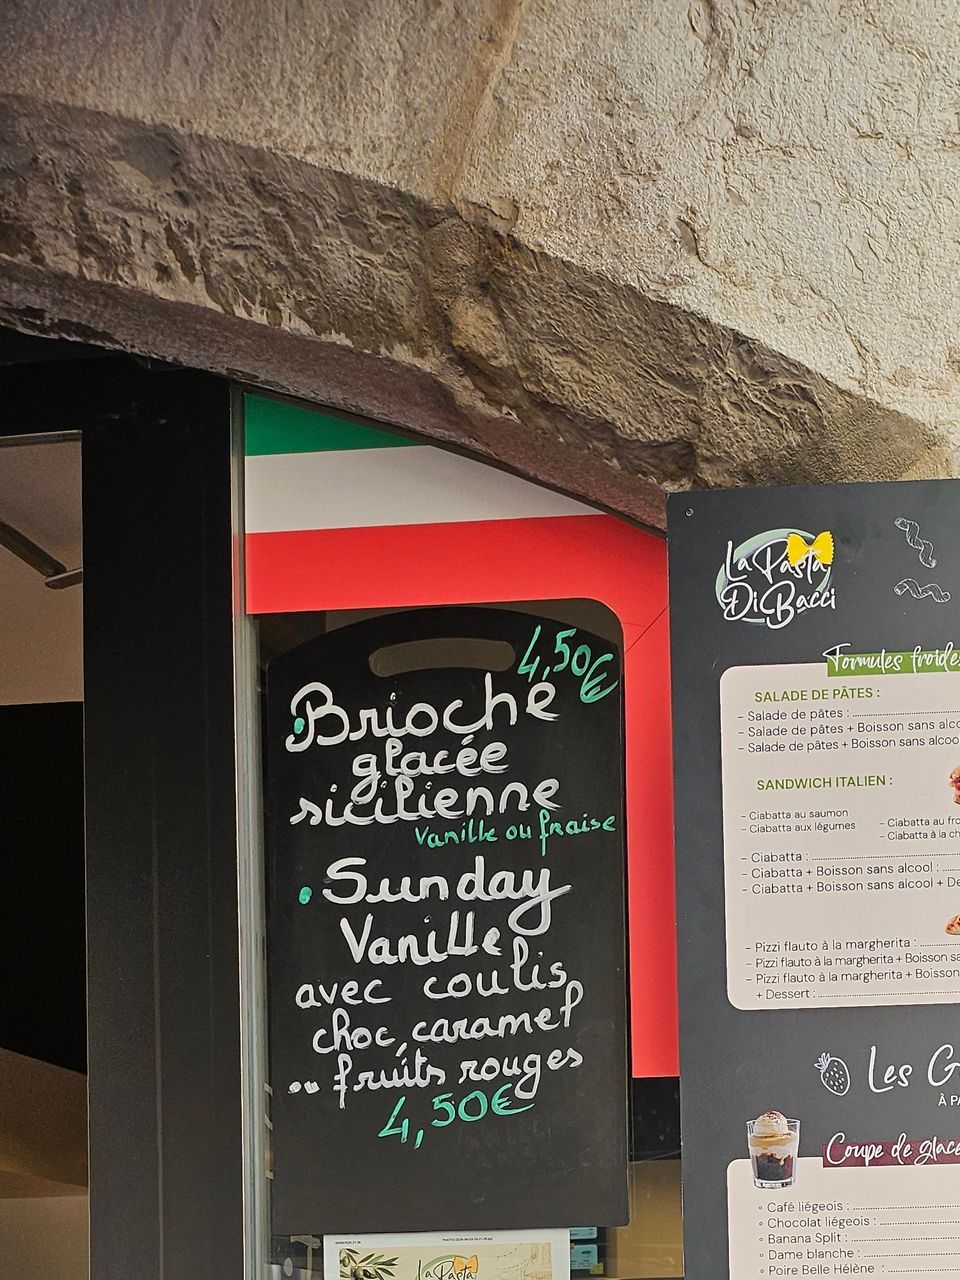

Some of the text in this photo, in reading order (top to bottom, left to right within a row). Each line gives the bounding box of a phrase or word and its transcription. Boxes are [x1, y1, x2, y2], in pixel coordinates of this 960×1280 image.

[726, 540, 828, 582] La Pasta
[517, 625, 618, 703] 4,50€
[822, 643, 903, 672] Formules
[285, 672, 560, 752] Brioche
[748, 710, 787, 722] Salade
[791, 709, 806, 720] de
[810, 708, 843, 723] pâtes
[755, 686, 874, 703] SALADE DE PÂTES
[350, 735, 509, 805] glacée
[757, 775, 886, 791] SANDWICH ITALIEN
[290, 776, 564, 826] sicilienne
[414, 810, 617, 856] Vanille ou fraise
[323, 856, 572, 936] Sunday
[340, 911, 502, 965] Vanille
[295, 936, 567, 1009] avec coulis
[334, 1048, 446, 1109] fruits
[459, 1047, 583, 1100] rouges
[868, 1046, 912, 1093] Les
[378, 1083, 534, 1150] 4,50€
[938, 1092, 947, 1106] À
[826, 1133, 884, 1166] Coupe
[891, 1134, 913, 1158] de
[767, 1202, 795, 1213] Café
[799, 1200, 843, 1214] liégeois
